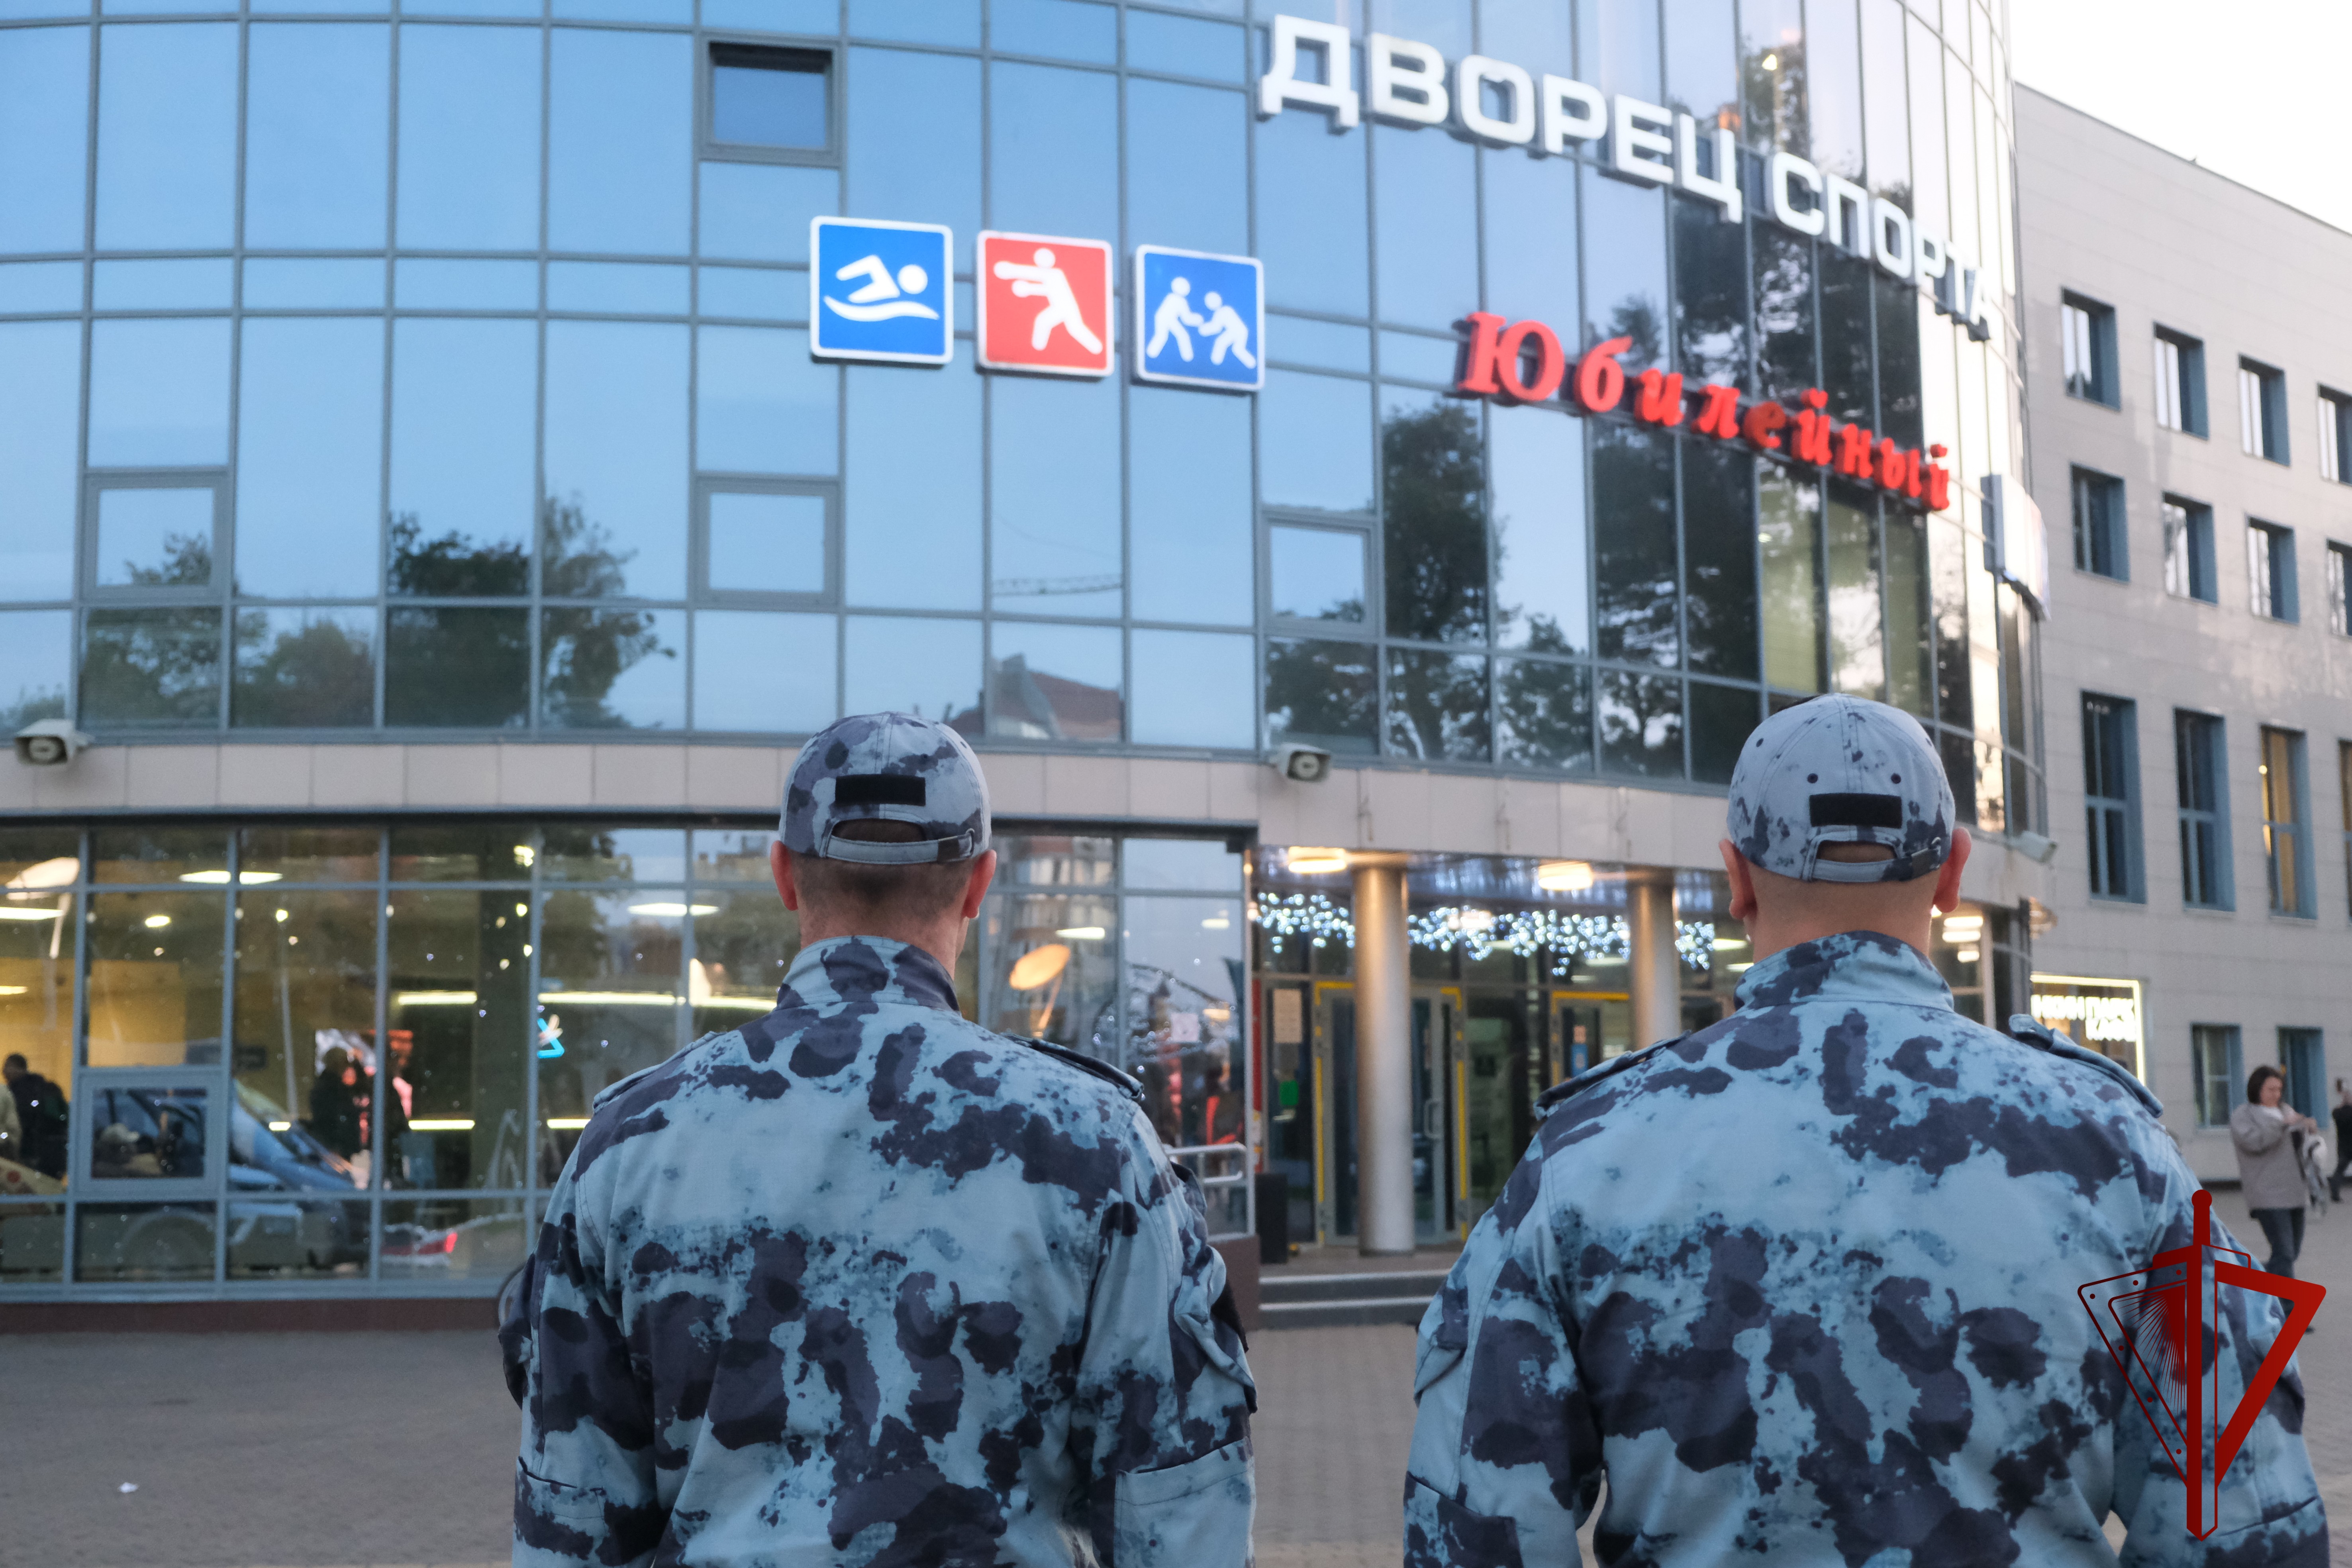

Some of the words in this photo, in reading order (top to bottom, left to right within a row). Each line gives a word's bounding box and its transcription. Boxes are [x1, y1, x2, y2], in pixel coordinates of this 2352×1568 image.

[1261, 13, 1743, 224] ДВОРЕЦ
[1772, 151, 1996, 339] СПОРТА
[1457, 311, 1950, 510] Юбилейный
